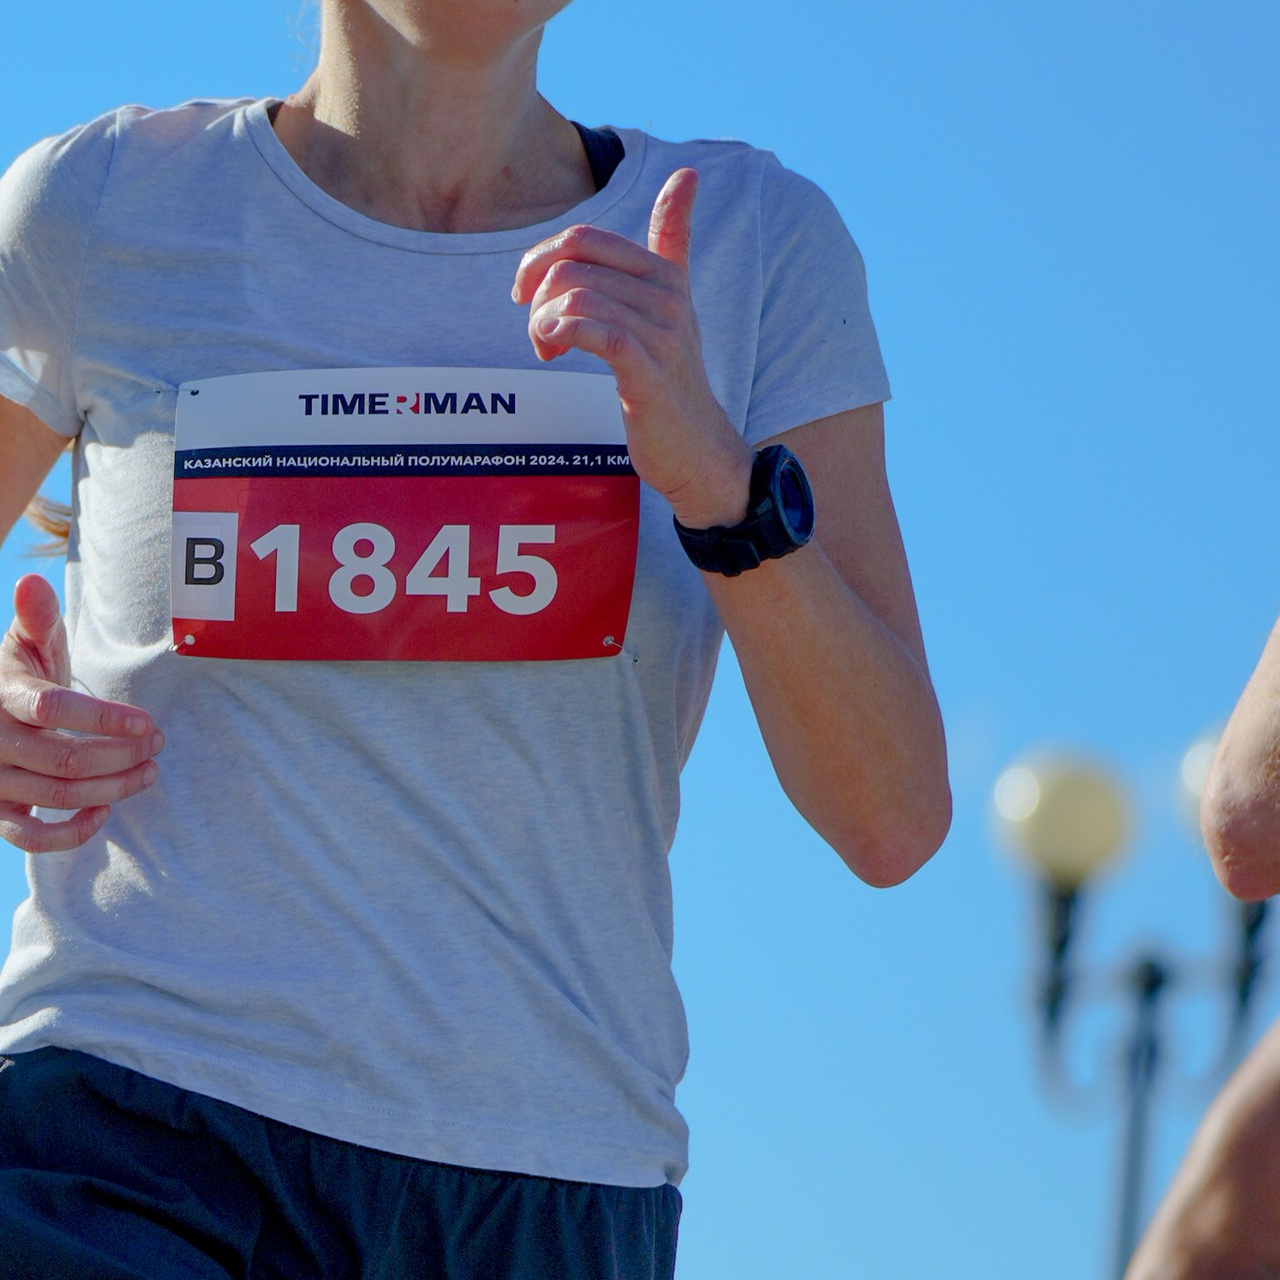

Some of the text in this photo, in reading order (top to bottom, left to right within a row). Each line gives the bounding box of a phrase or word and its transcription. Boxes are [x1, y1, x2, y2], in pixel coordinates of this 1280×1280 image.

[184, 455, 273, 470] КАЗАНСКИЙ
[276, 454, 405, 469] НАЦИОНАЛЬНЫЙ
[408, 455, 526, 467] ПОЛУМАРАФОН
[529, 455, 570, 466] 2024.
[572, 455, 602, 467] 21,1
[184, 522, 559, 616] B 1845
